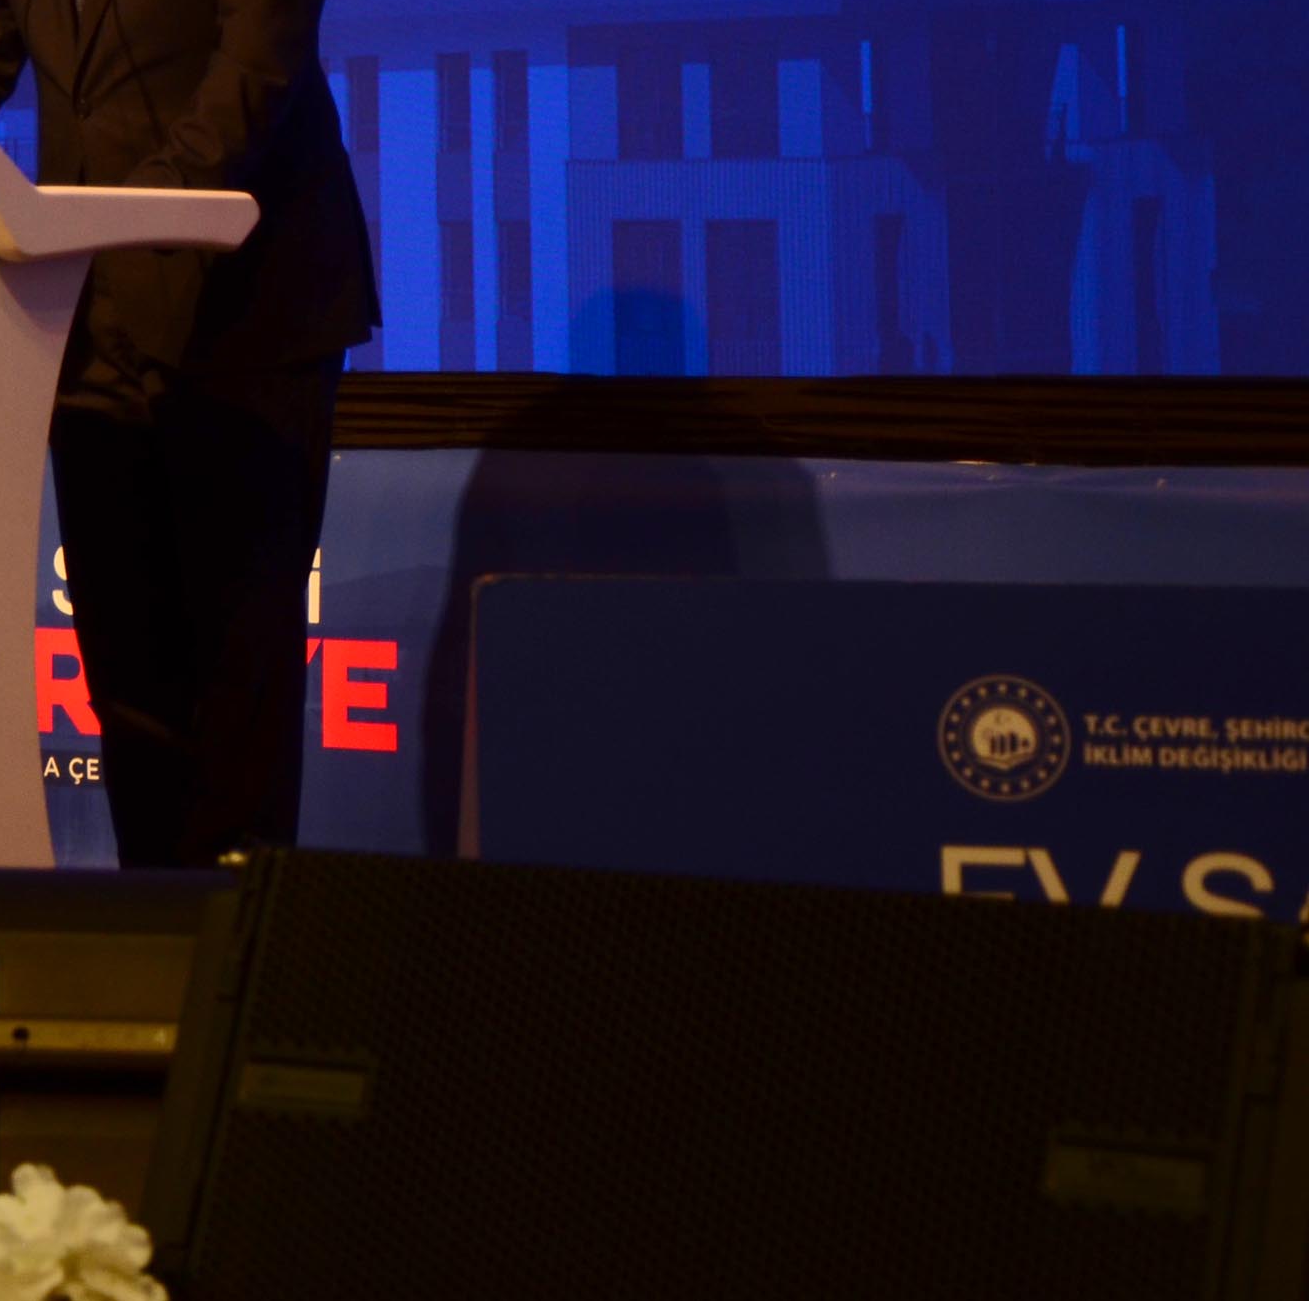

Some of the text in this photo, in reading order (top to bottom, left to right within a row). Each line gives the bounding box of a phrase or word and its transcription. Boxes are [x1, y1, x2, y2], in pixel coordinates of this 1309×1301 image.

[1084, 714, 1128, 735] T.C.
[1133, 716, 1219, 741] ÇEVRE,
[1084, 743, 1153, 766] İKLİM
